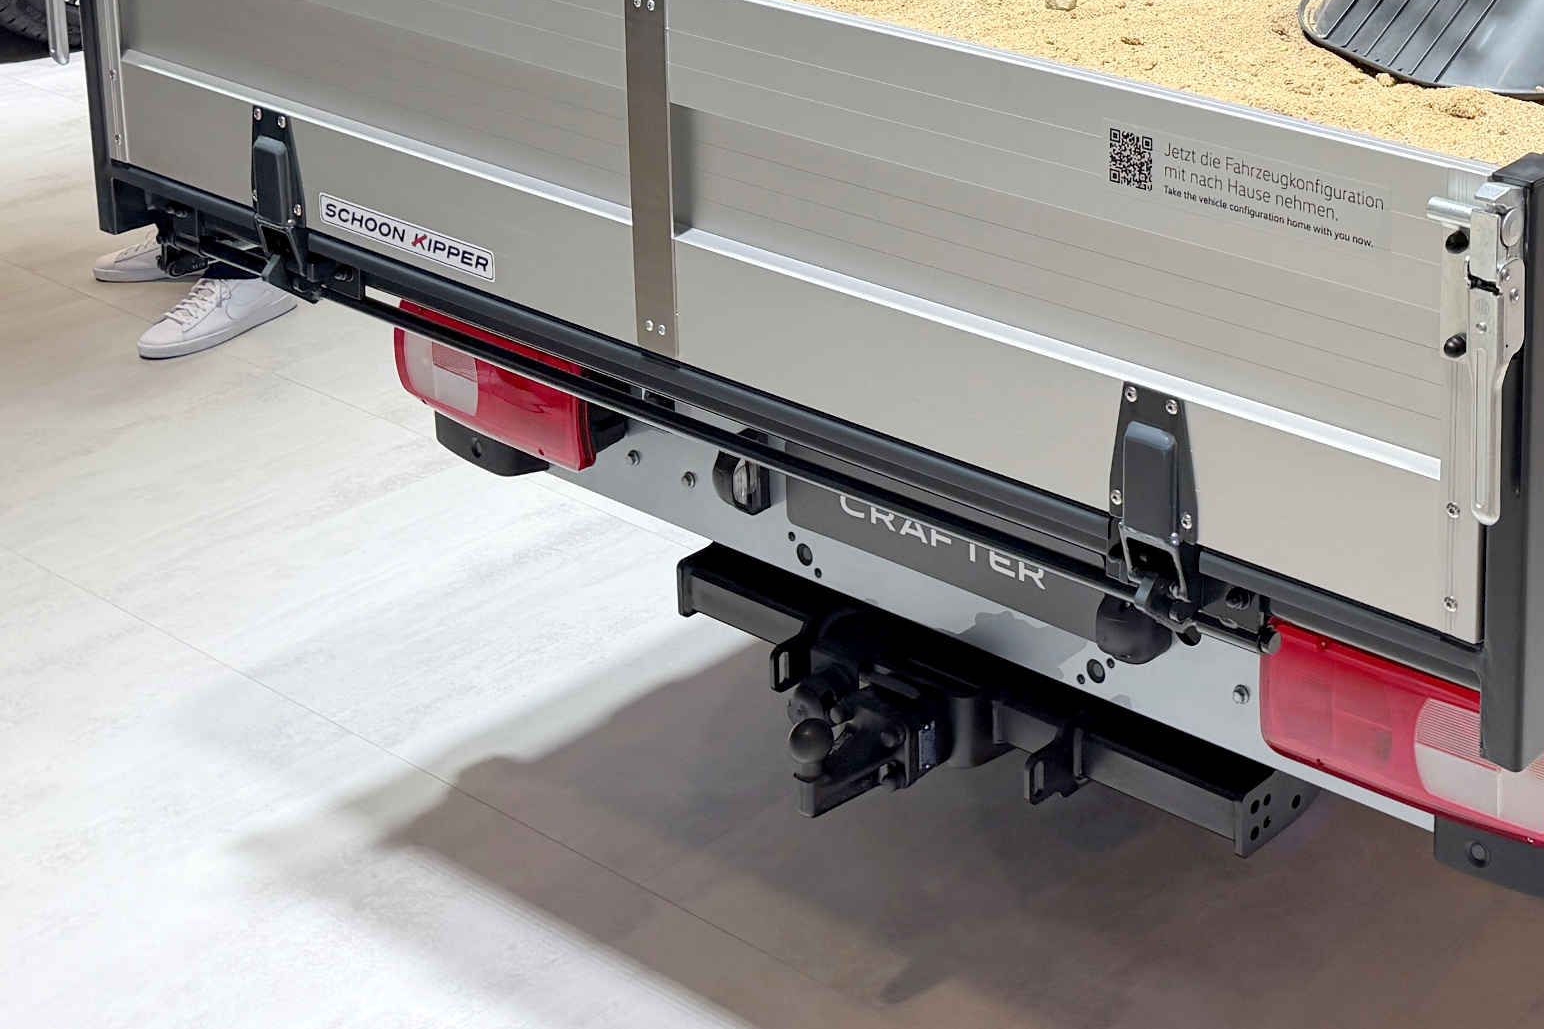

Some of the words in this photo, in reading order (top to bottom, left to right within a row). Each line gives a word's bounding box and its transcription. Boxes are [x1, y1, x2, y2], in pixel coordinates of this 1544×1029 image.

[1164, 142, 1197, 164] Jetzt
[1200, 151, 1221, 169] die
[1225, 156, 1384, 211] Fahrzeugkonfiguration
[1164, 166, 1186, 182] mit
[1190, 172, 1223, 191] nach
[1228, 178, 1271, 203] Hause
[1275, 193, 1339, 222] nehmen.
[325, 203, 406, 243] SCHOON
[411, 232, 490, 272] KIPPER
[1164, 185, 1182, 198] Take
[1184, 190, 1197, 202] the
[1199, 196, 1227, 209] vehicle
[1229, 202, 1285, 224] configuration
[1286, 217, 1312, 232] home
[1313, 224, 1333, 237] with
[1334, 230, 1350, 241] you
[1352, 234, 1375, 248] now.
[839, 494, 1046, 591] CRAFTER
